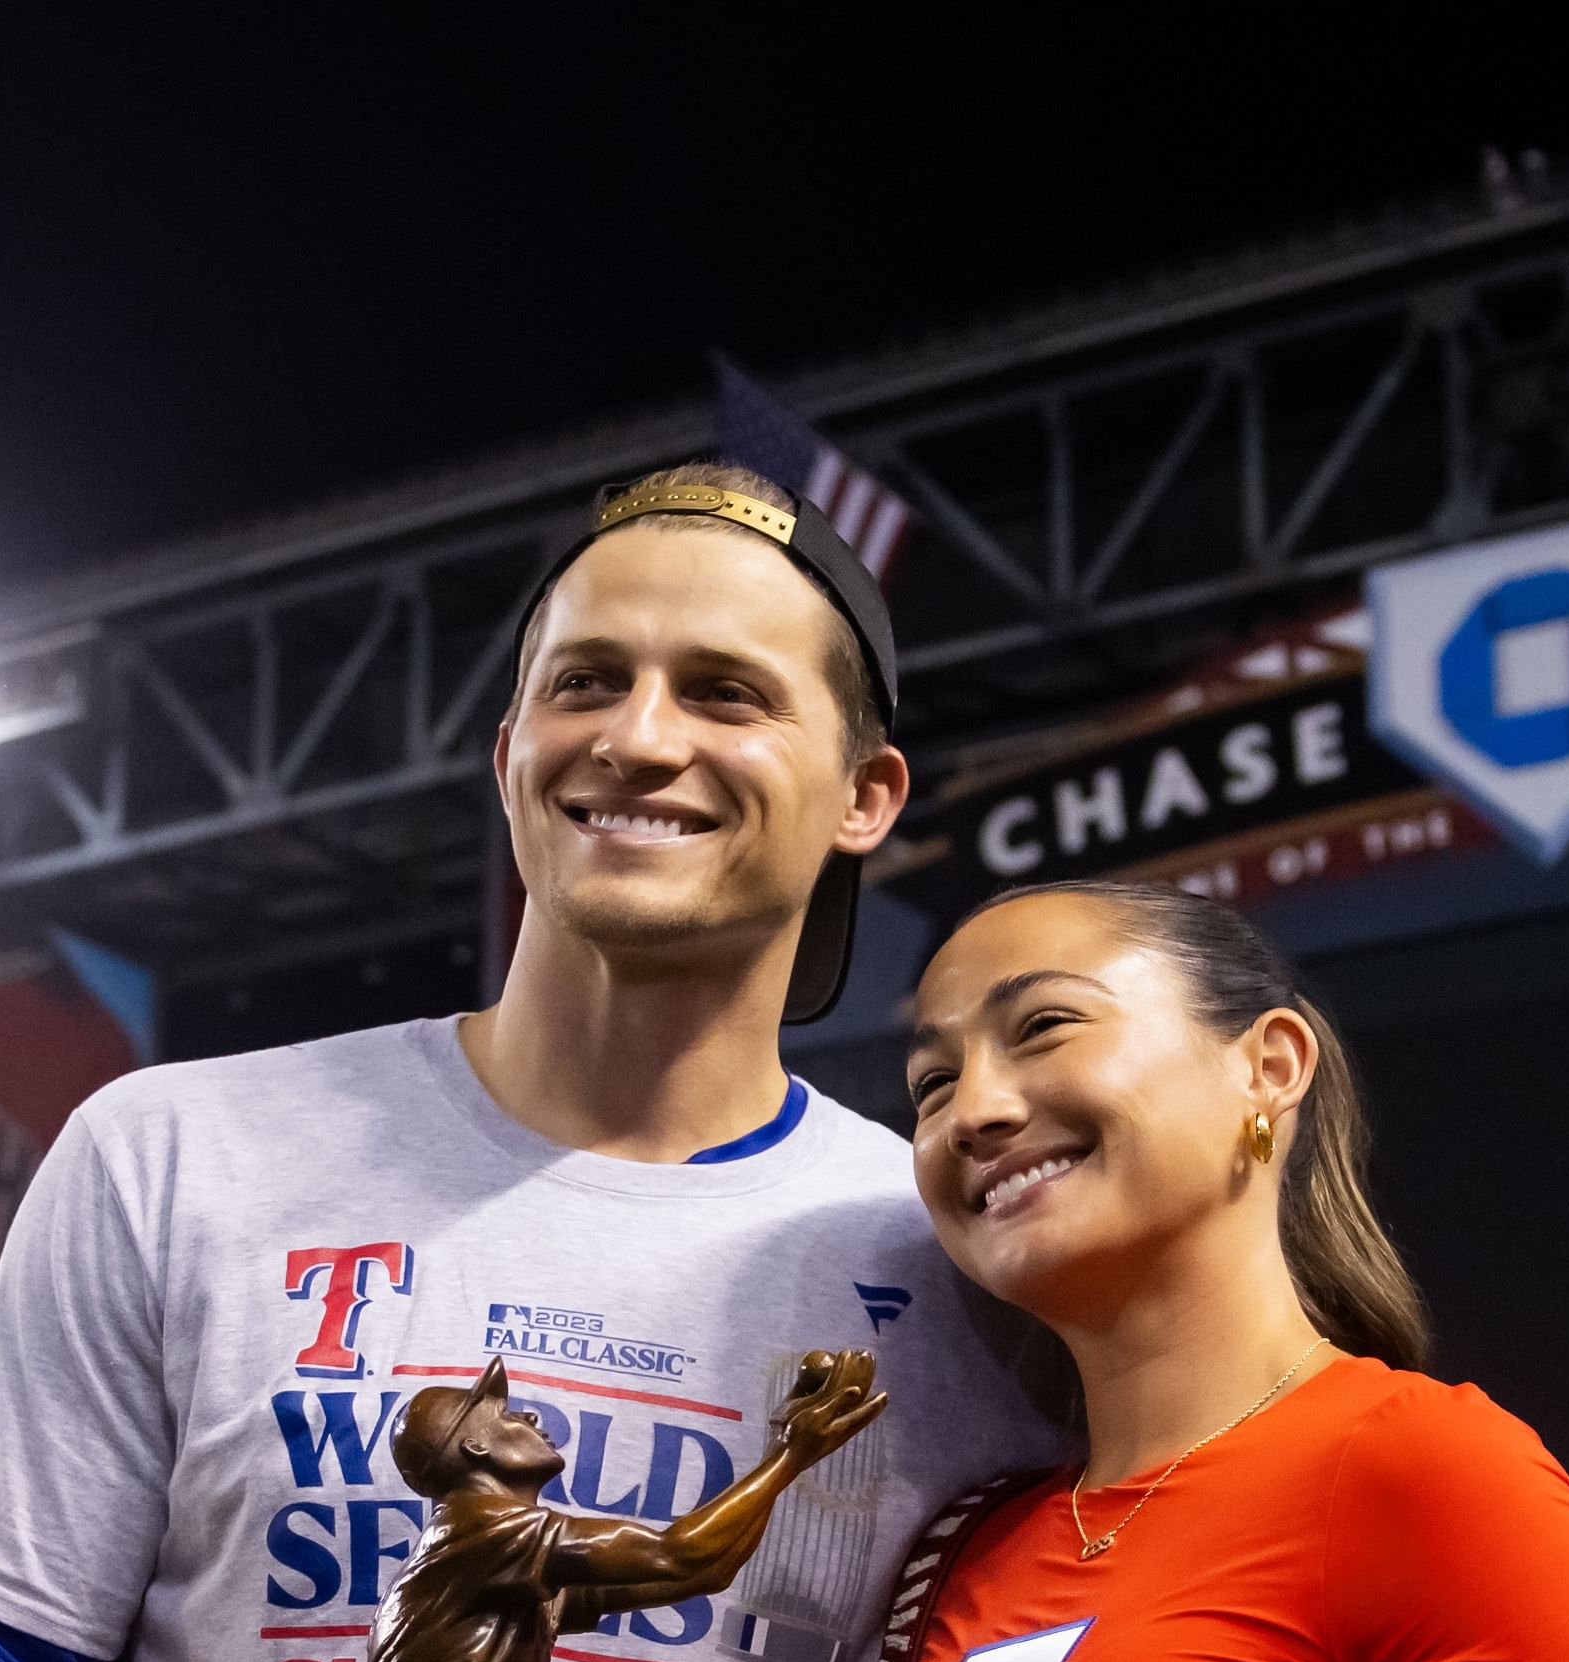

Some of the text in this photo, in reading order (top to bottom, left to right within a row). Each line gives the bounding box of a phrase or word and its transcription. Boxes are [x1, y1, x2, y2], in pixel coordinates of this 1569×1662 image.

[979, 702, 1349, 876] CHASE
[1267, 838, 1328, 884] OF
[1361, 806, 1451, 859] THE
[285, 1242, 415, 1380] T
[484, 1327, 556, 1356] FALL
[535, 1311, 604, 1332] 2023
